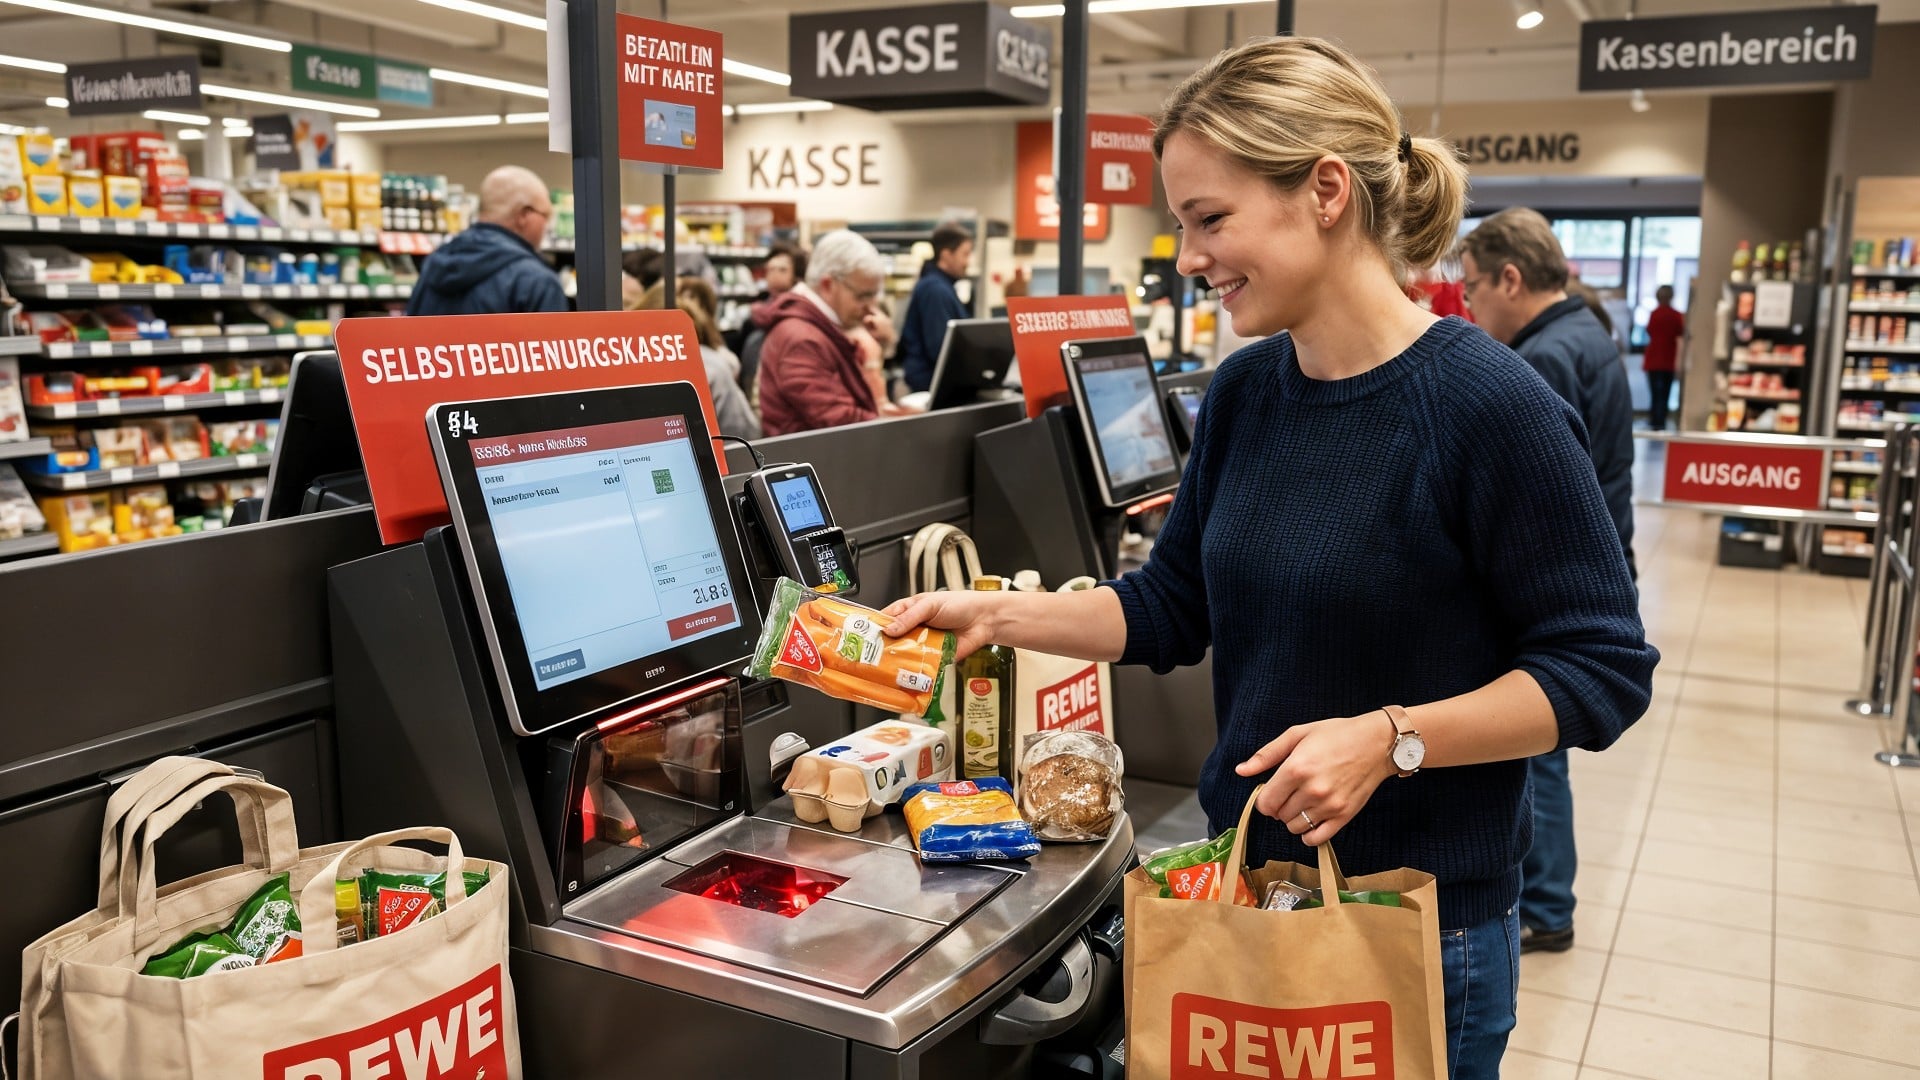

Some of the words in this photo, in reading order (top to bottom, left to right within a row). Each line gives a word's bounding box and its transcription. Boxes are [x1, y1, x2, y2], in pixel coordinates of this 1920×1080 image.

[816, 23, 959, 78] KASSE
[1597, 25, 1857, 71] Kassenbereich
[624, 62, 659, 86] MIT
[748, 144, 880, 189] KASSE
[1681, 462, 1801, 490] AUSGANG
[1188, 1012, 1376, 1079] REWE
